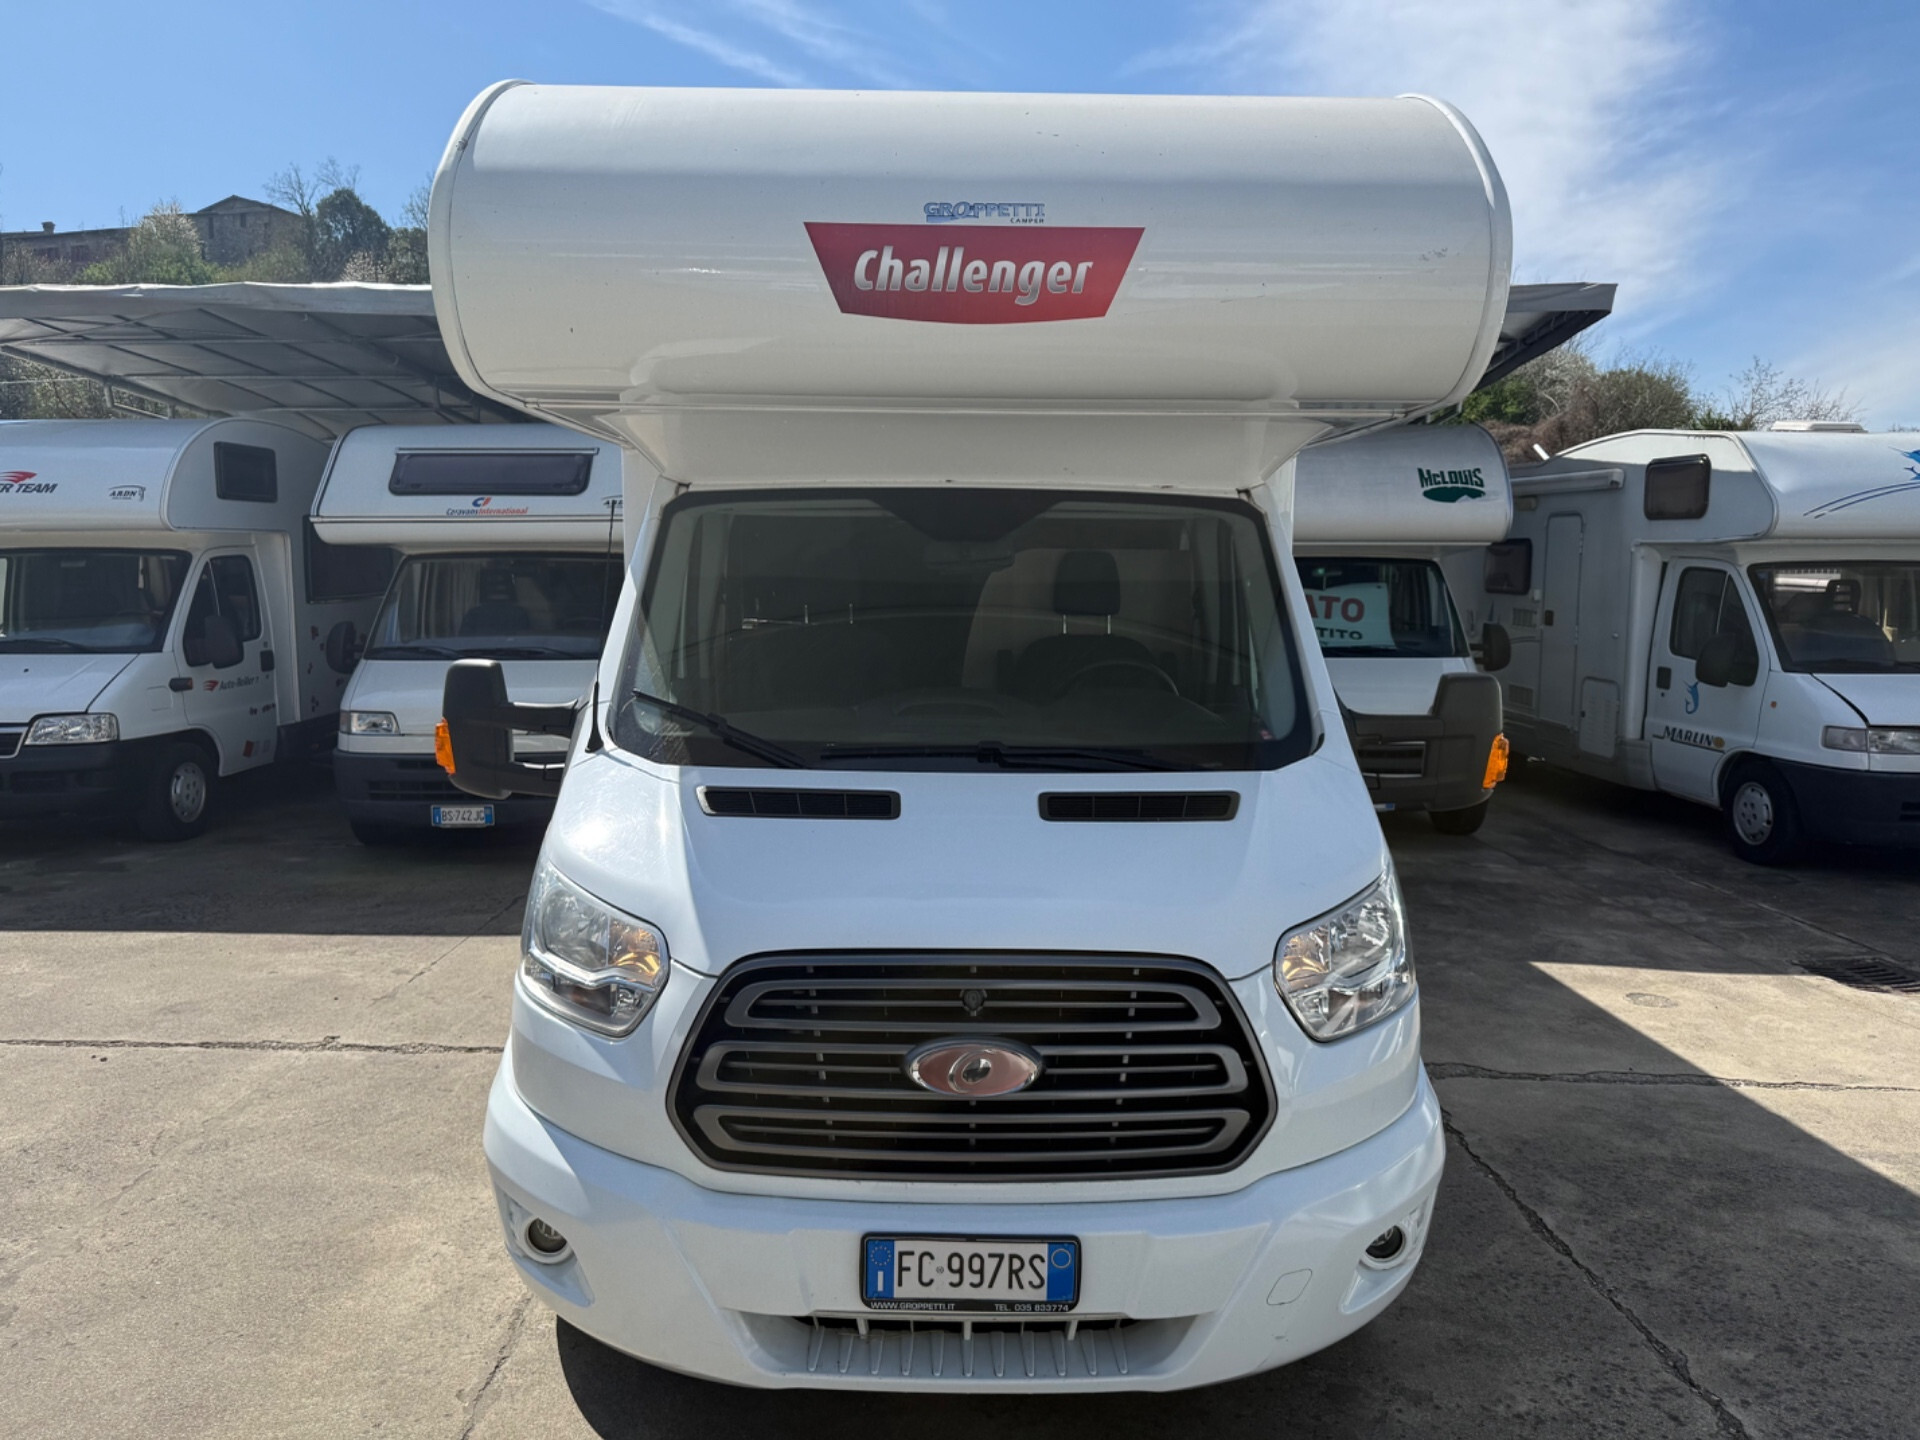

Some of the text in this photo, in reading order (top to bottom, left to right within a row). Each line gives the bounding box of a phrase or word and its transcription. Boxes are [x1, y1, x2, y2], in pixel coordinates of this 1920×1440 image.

[923, 201, 1046, 219] GROPPETTI
[853, 245, 1094, 306] Challenger
[15, 483, 58, 493] TEAM
[1663, 725, 1714, 747] MARLIN
[870, 1301, 956, 1311] WWW.GROPPETTI.IT
[1014, 1304, 1032, 1312] 035
[1034, 1304, 1069, 1313] 833774
